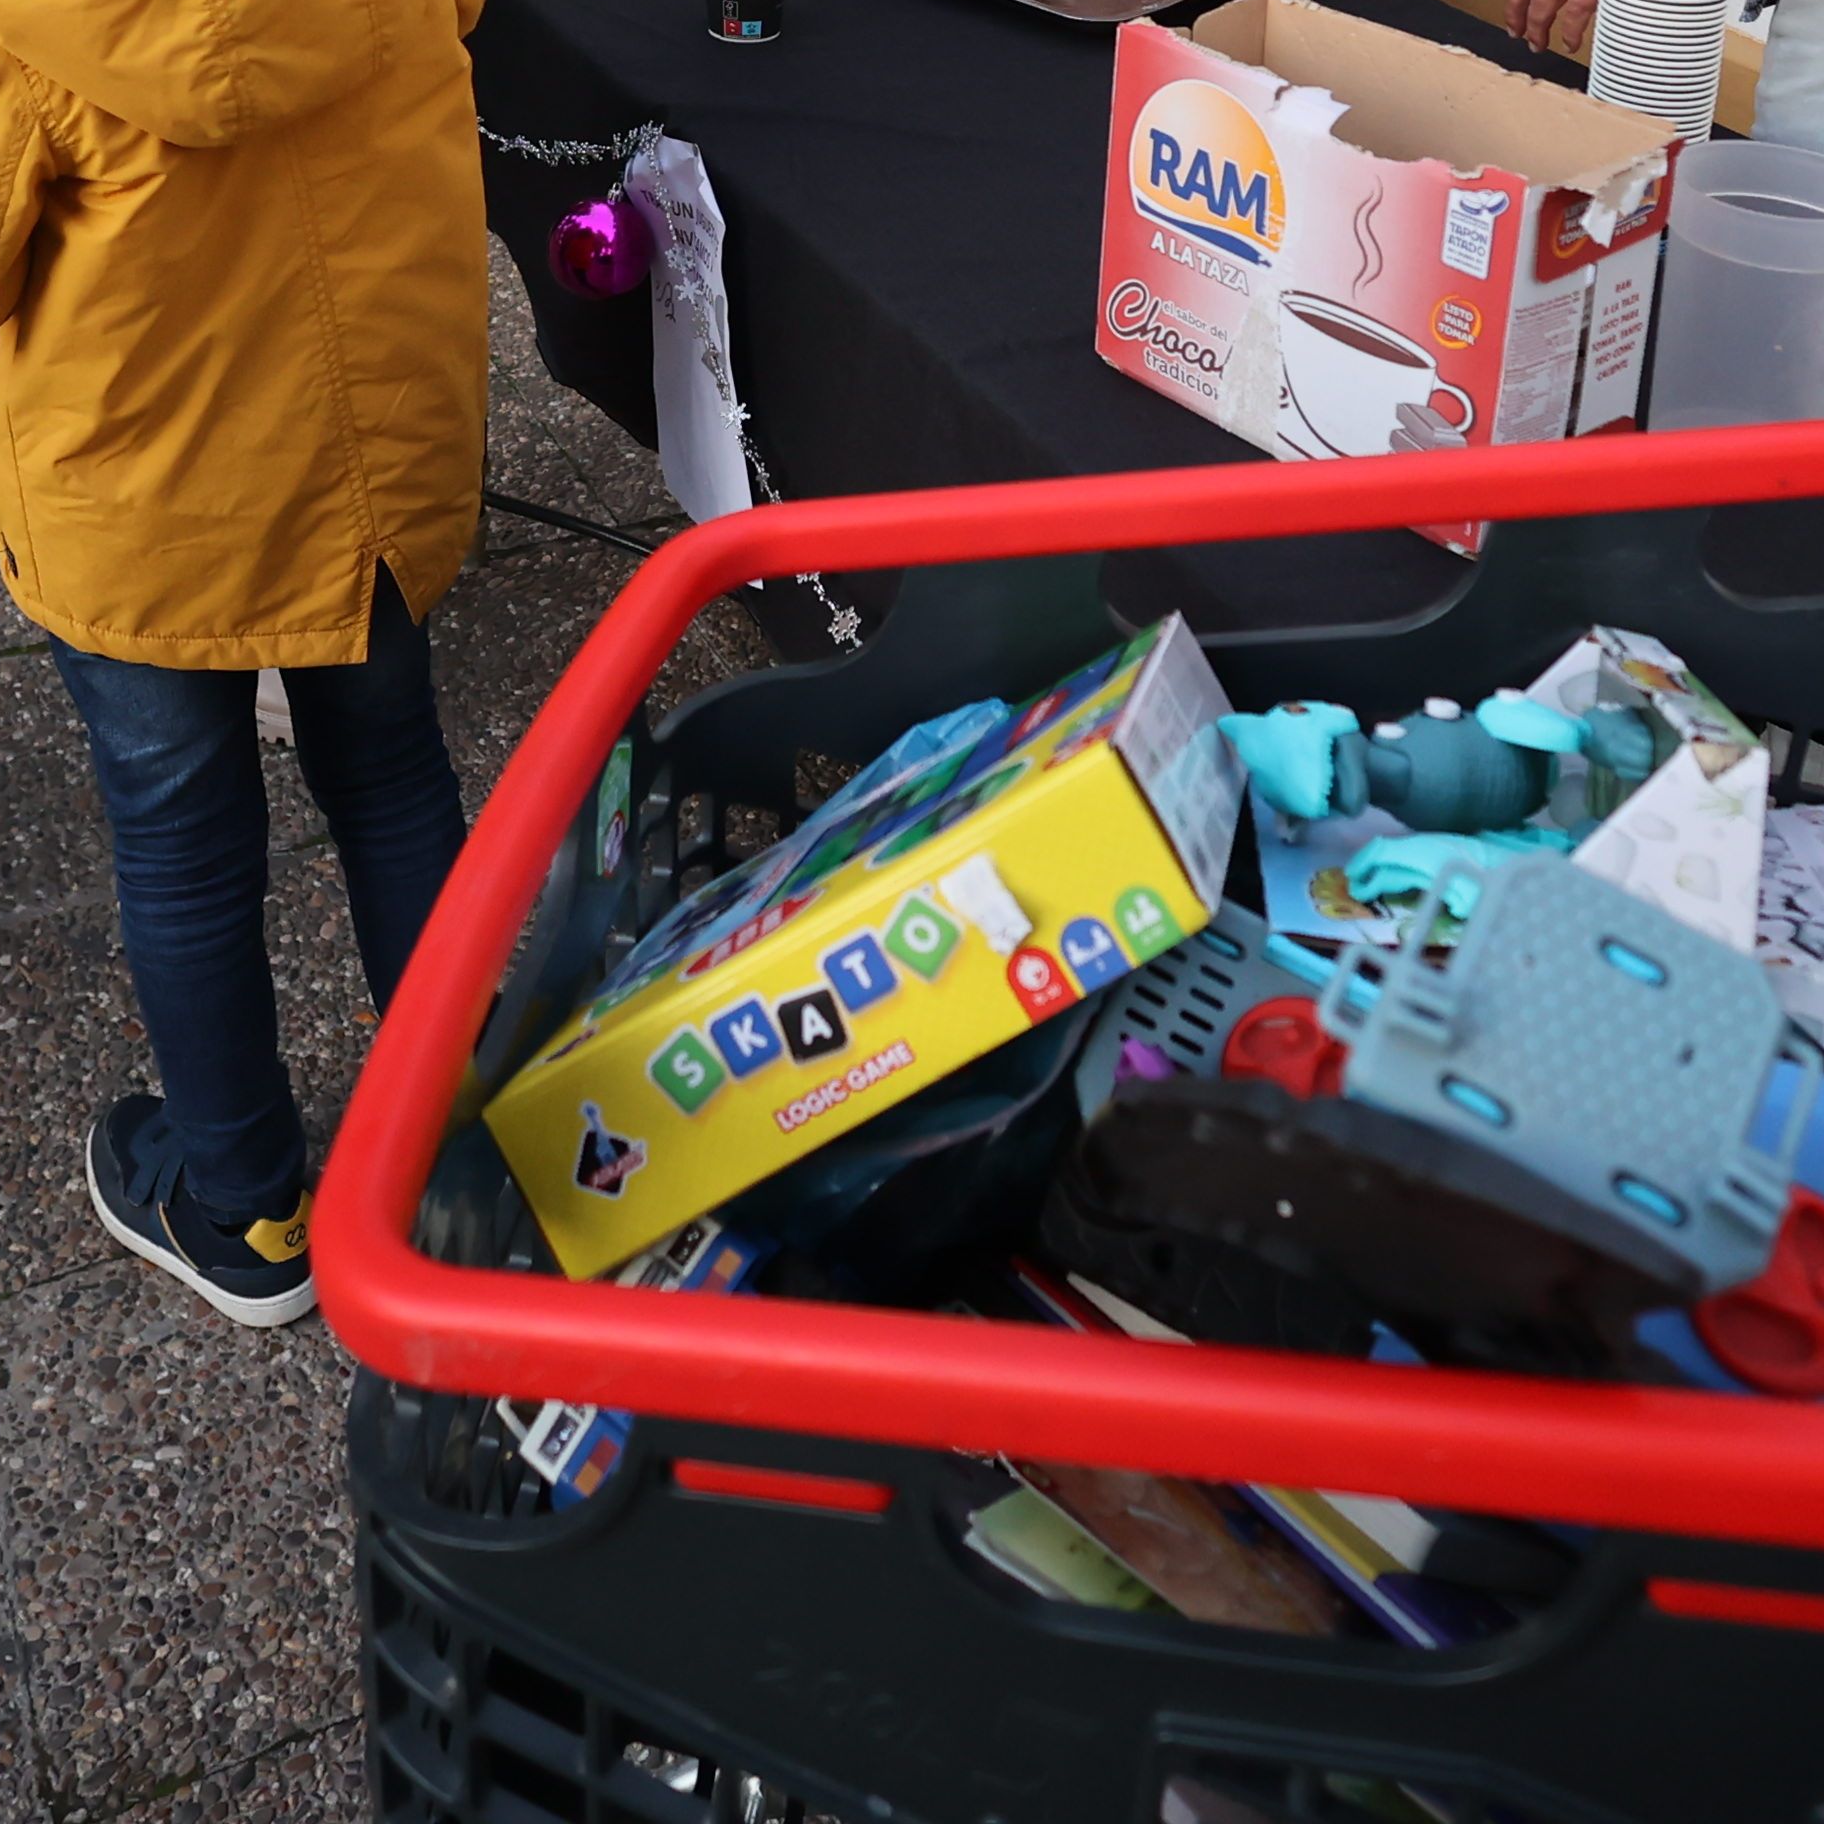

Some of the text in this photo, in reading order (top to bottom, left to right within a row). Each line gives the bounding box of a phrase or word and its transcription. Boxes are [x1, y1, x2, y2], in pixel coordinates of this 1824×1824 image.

[1149, 127, 1268, 237] RAM
[1151, 231, 1250, 296] A LA TAZA
[1163, 300, 1228, 342] el sabor del
[1438, 322, 1476, 346] TOMAR
[1443, 302, 1474, 322] LISTO
[1443, 313, 1471, 332] PARA
[672, 913, 941, 1089] SKATO
[776, 1040, 914, 1131] LOGIC GAME
